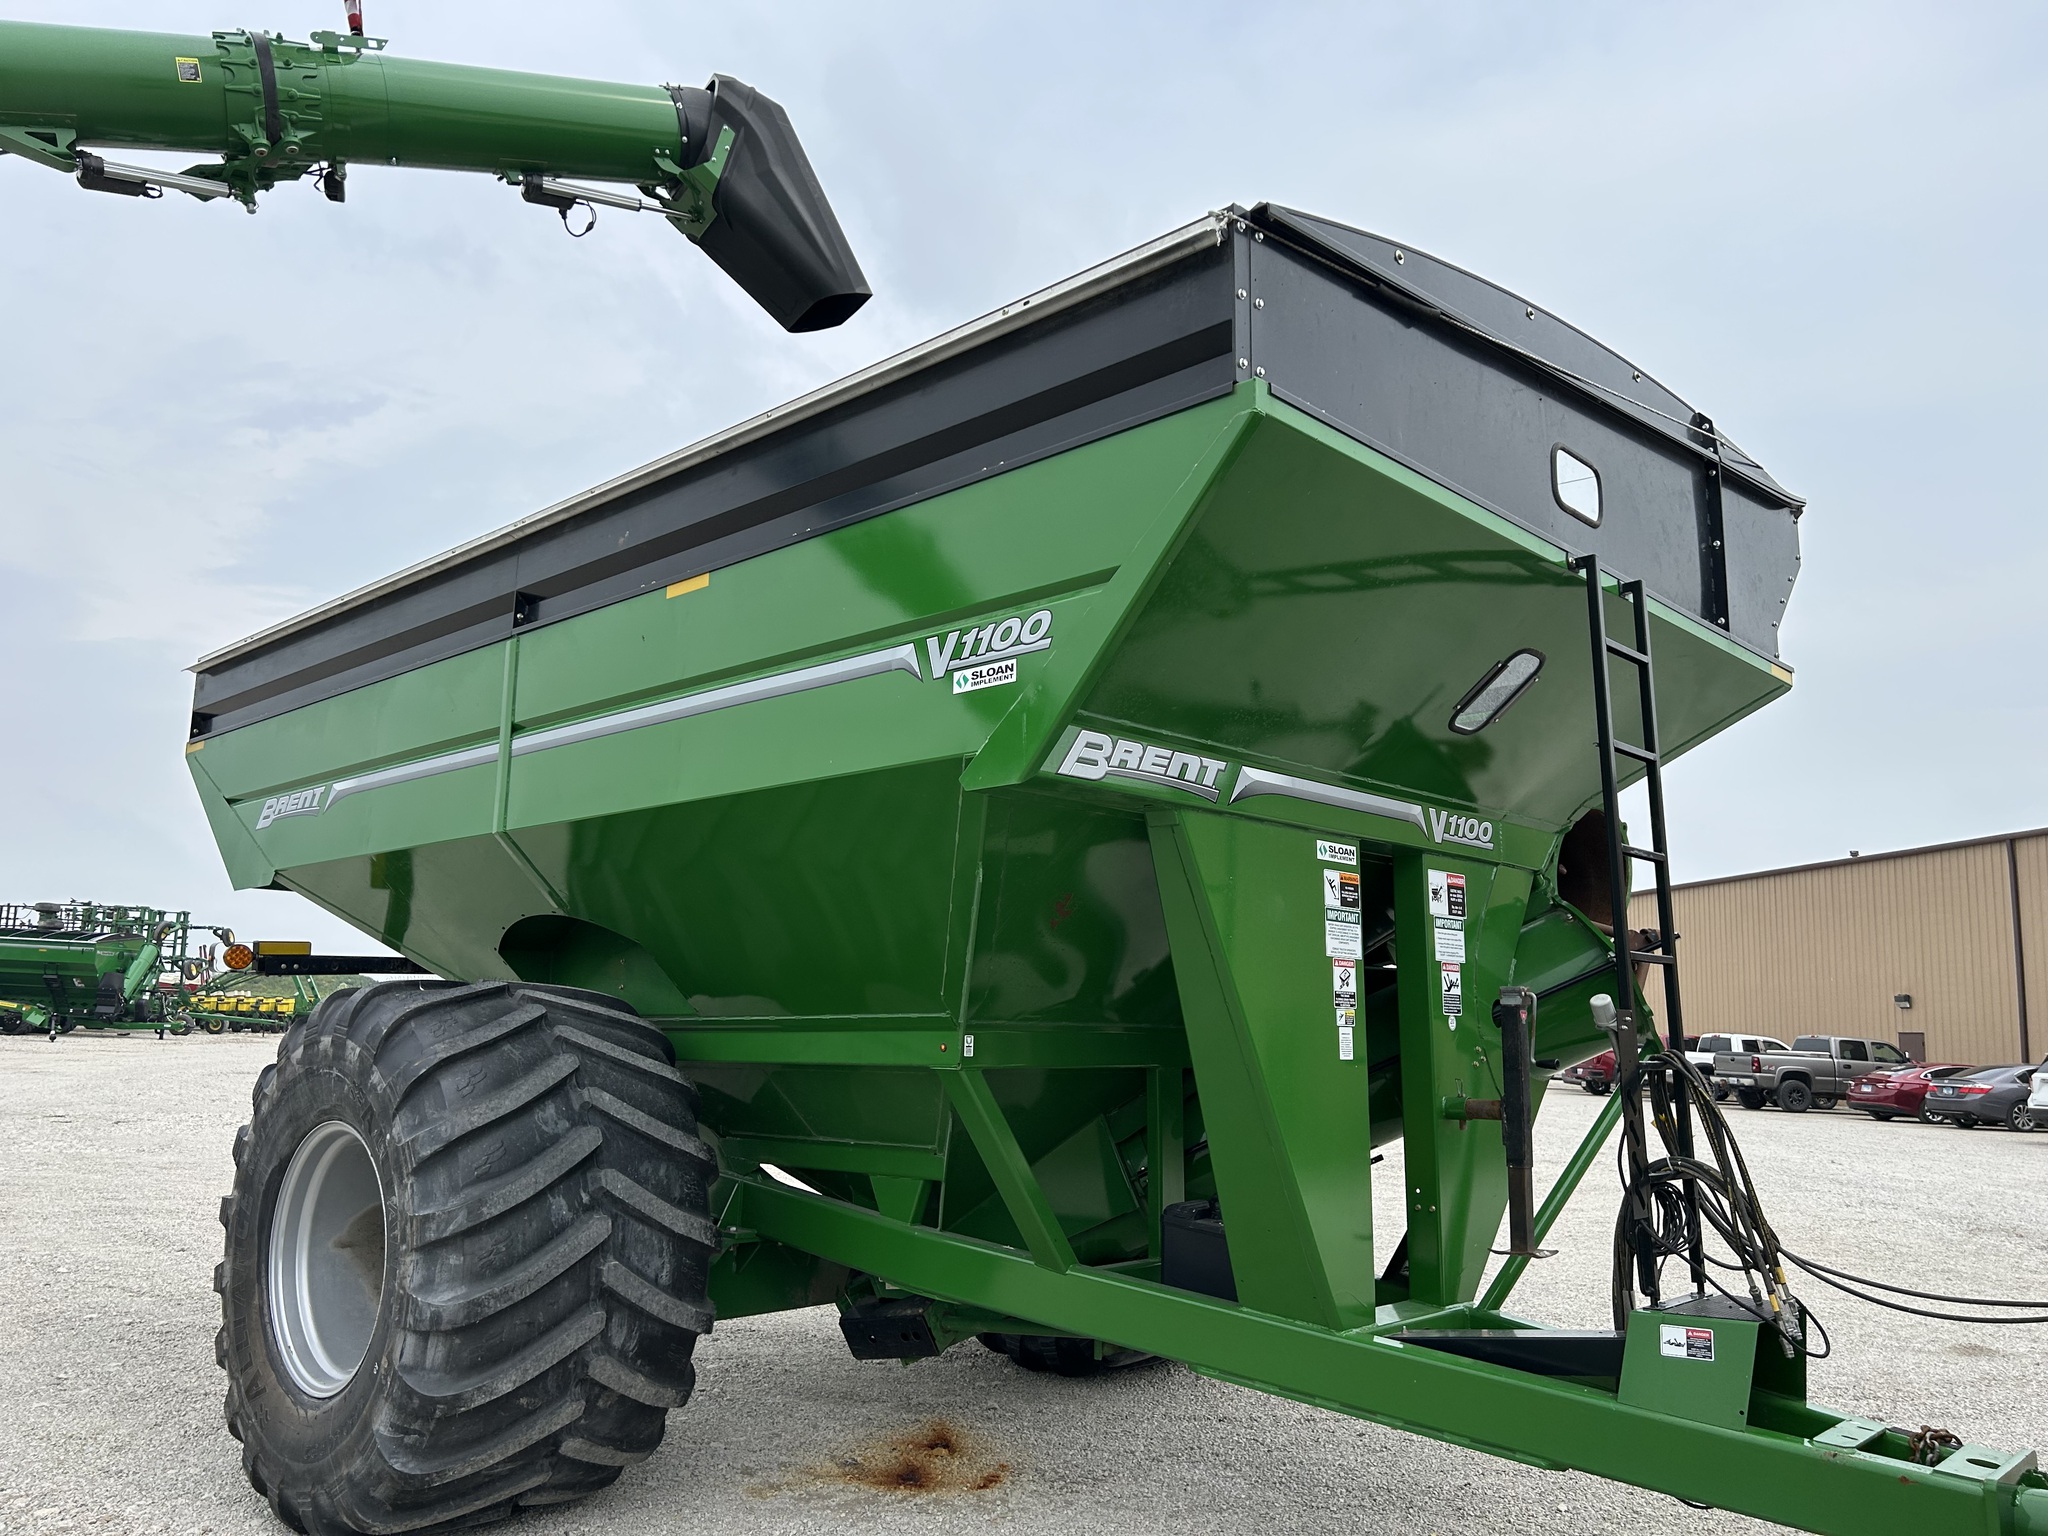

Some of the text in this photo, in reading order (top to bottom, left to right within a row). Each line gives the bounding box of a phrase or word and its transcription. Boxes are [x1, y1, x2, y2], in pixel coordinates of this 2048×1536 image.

[926, 609, 1053, 680] V1100
[971, 663, 1015, 681] SLOAN
[970, 673, 1014, 688] IMPLEMENT
[1056, 729, 1228, 788] BRENT
[256, 786, 326, 830] BRENT
[1428, 807, 1493, 844] V1100
[1328, 845, 1355, 857] SLOAN
[1328, 854, 1355, 863] IMPLEMENT
[1327, 909, 1359, 924] IMPORTANT
[1435, 917, 1463, 930] IMPORTANT
[1445, 963, 1460, 971] DANGER
